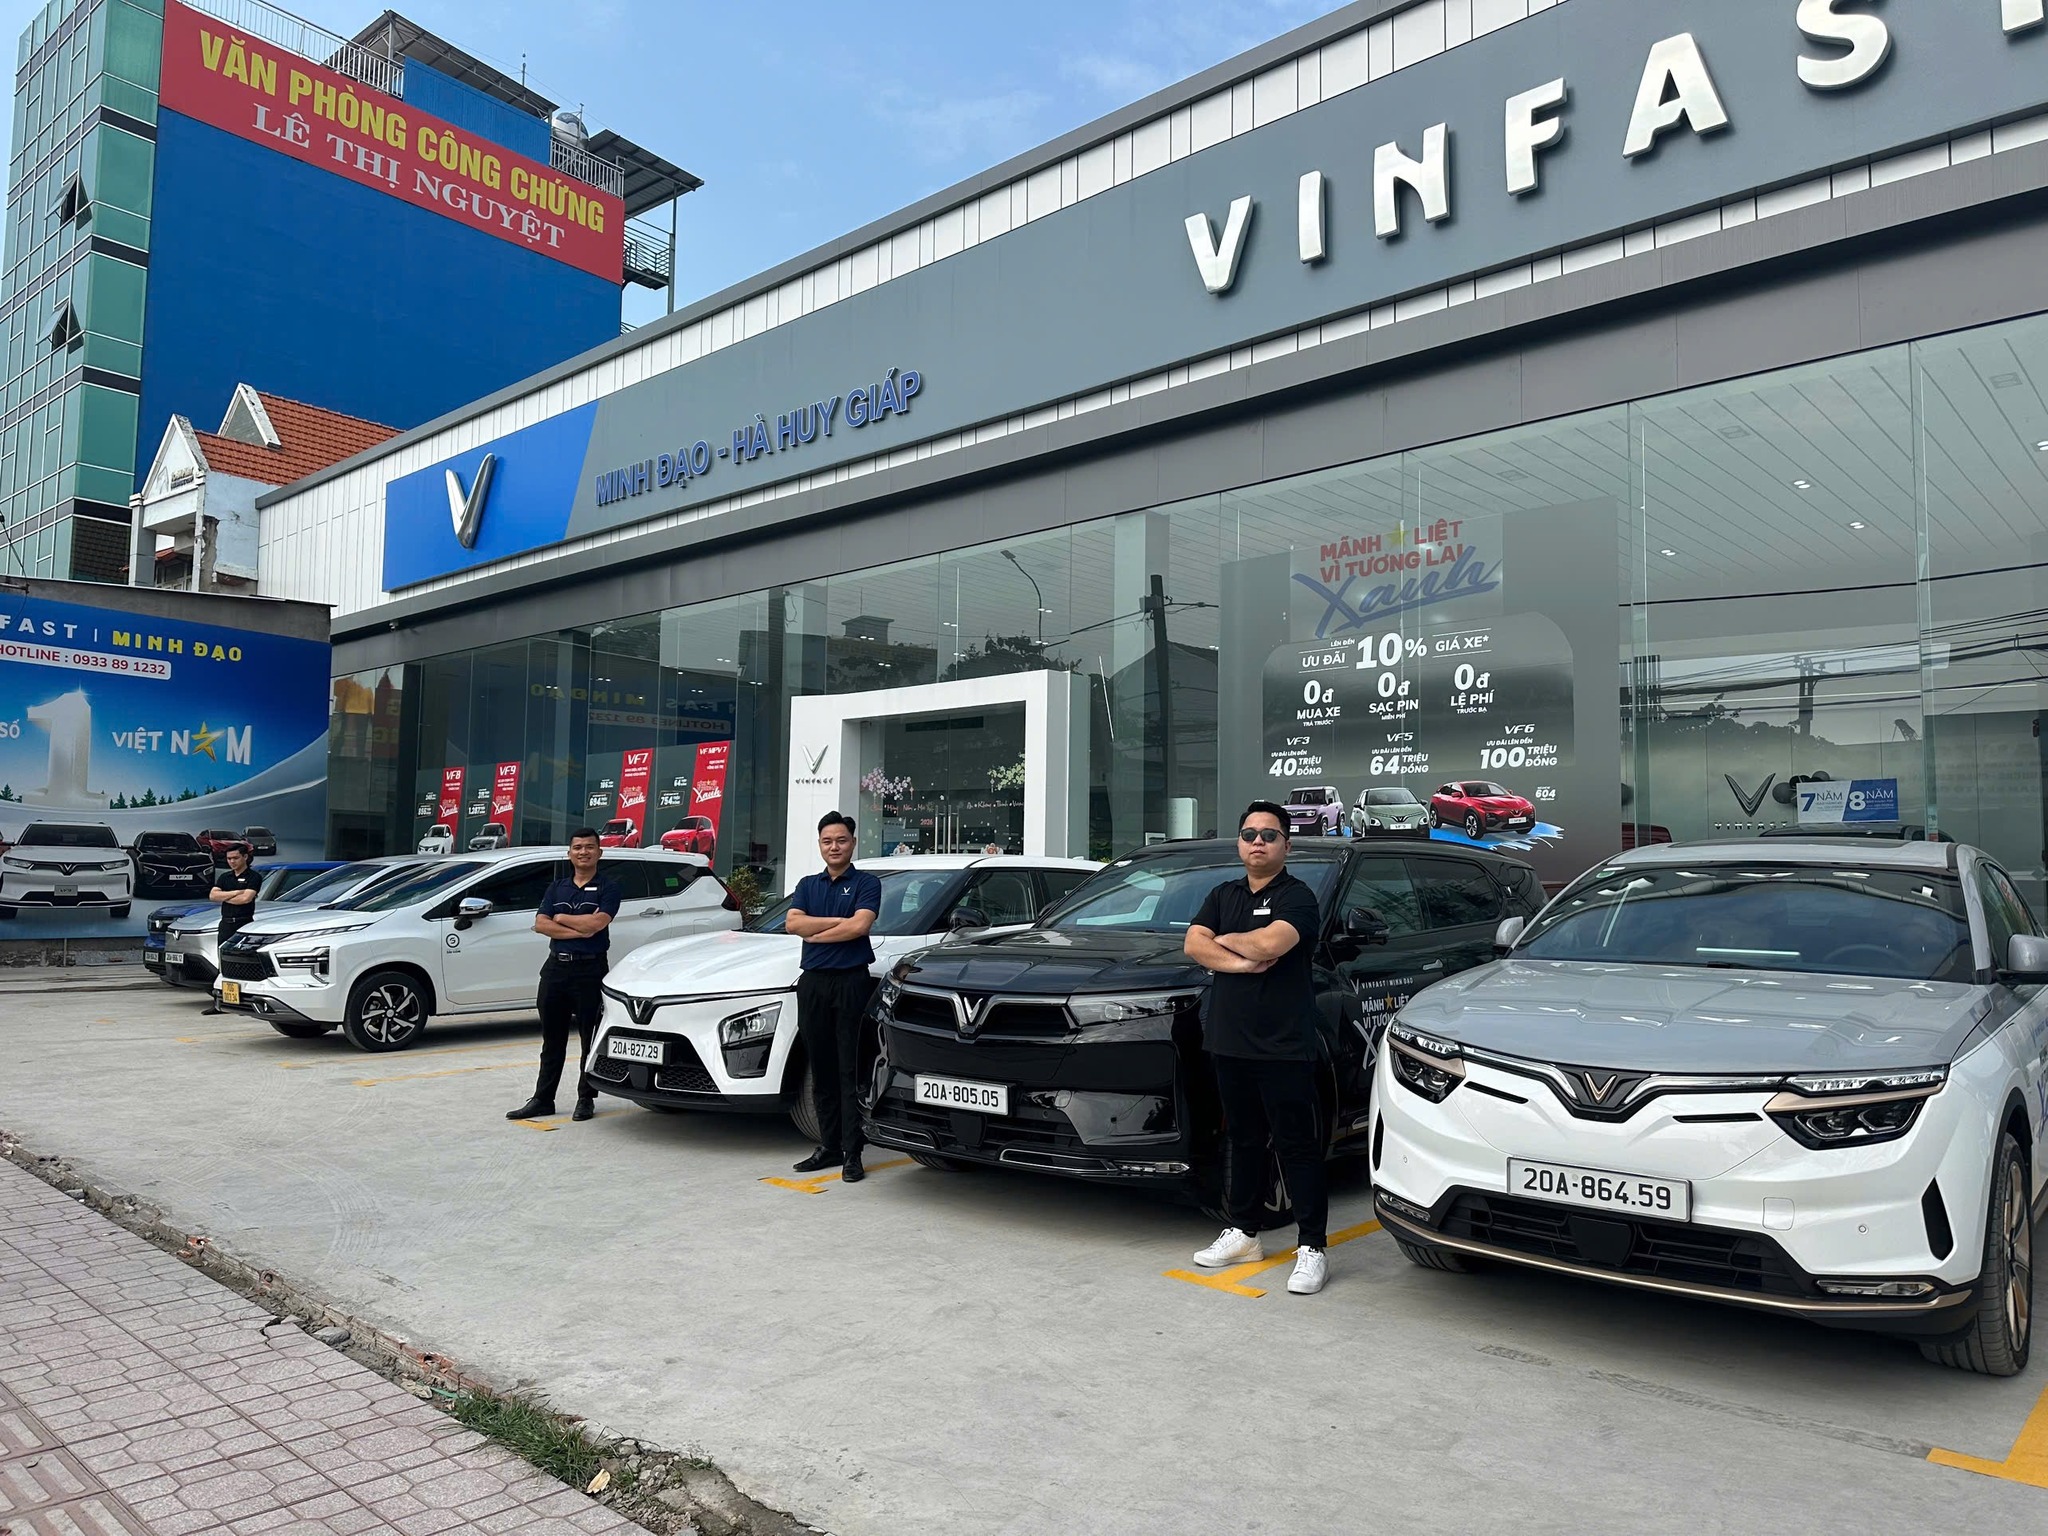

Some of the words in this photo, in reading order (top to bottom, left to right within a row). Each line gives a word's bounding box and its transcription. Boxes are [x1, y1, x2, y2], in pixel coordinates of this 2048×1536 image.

[200, 29, 277, 96] VĂN
[289, 68, 406, 151] PHÒNG
[417, 126, 501, 190] CÔNG
[510, 166, 605, 234] CHỨNG
[1184, 0, 2048, 295] VINFAS
[252, 102, 310, 149] LÊ
[326, 132, 401, 189] THỊ
[412, 168, 566, 249] NGUYỆT
[594, 458, 651, 507] MINH
[656, 439, 712, 489] ĐẠO
[731, 412, 774, 465] HÀ
[776, 395, 842, 451] HUY
[844, 366, 925, 429] GIÁP
[1320, 535, 1382, 562] MÃNH
[1414, 518, 1463, 547] LIỆT
[1320, 562, 1341, 583] VÌ
[1344, 550, 1421, 578] TƯƠNG
[1425, 543, 1463, 567] LAI
[1291, 546, 1503, 639] Xanh
[112, 630, 184, 654] MINH
[192, 640, 243, 662] ĐẠO
[1355, 632, 1428, 670] 10%
[1435, 638, 1461, 653] GIÁ
[72, 653, 108, 669] 0933
[111, 659, 129, 671] 89
[133, 660, 166, 676] 1232
[1302, 655, 1320, 668] ƯU
[1322, 650, 1346, 665] ĐÃI
[1368, 701, 1394, 716] SẠC
[1397, 699, 1419, 712] PIN
[1450, 691, 1467, 708] LỆ
[1469, 689, 1495, 705] PHÍ
[1296, 707, 1323, 721] MUA
[1325, 706, 1341, 718] XE
[1386, 731, 1414, 743] VF5
[1504, 723, 1536, 735] VF6
[112, 727, 163, 754] VIỆT
[1286, 736, 1310, 746] VF3
[1527, 743, 1558, 757] TRIỆU
[627, 753, 649, 765] VF7
[1269, 757, 1298, 777] 40
[1298, 755, 1322, 767] TRIỆU
[1370, 755, 1400, 776] 64
[1401, 752, 1429, 764] TRIỆU
[1480, 746, 1526, 770] 100
[499, 765, 517, 776] VF9
[1535, 789, 1557, 799] 604
[1800, 793, 1816, 812] 7
[1816, 790, 1843, 801] NĂM
[1848, 791, 1866, 811] 8
[1866, 788, 1894, 799] NĂM
[1361, 996, 1385, 1013] MÃNH
[1362, 1013, 1372, 1029] VÌ
[612, 1041, 659, 1059] 20A-827.29
[923, 1081, 999, 1108] 20A-805.05
[1523, 1166, 1672, 1210] 20A-864.59
